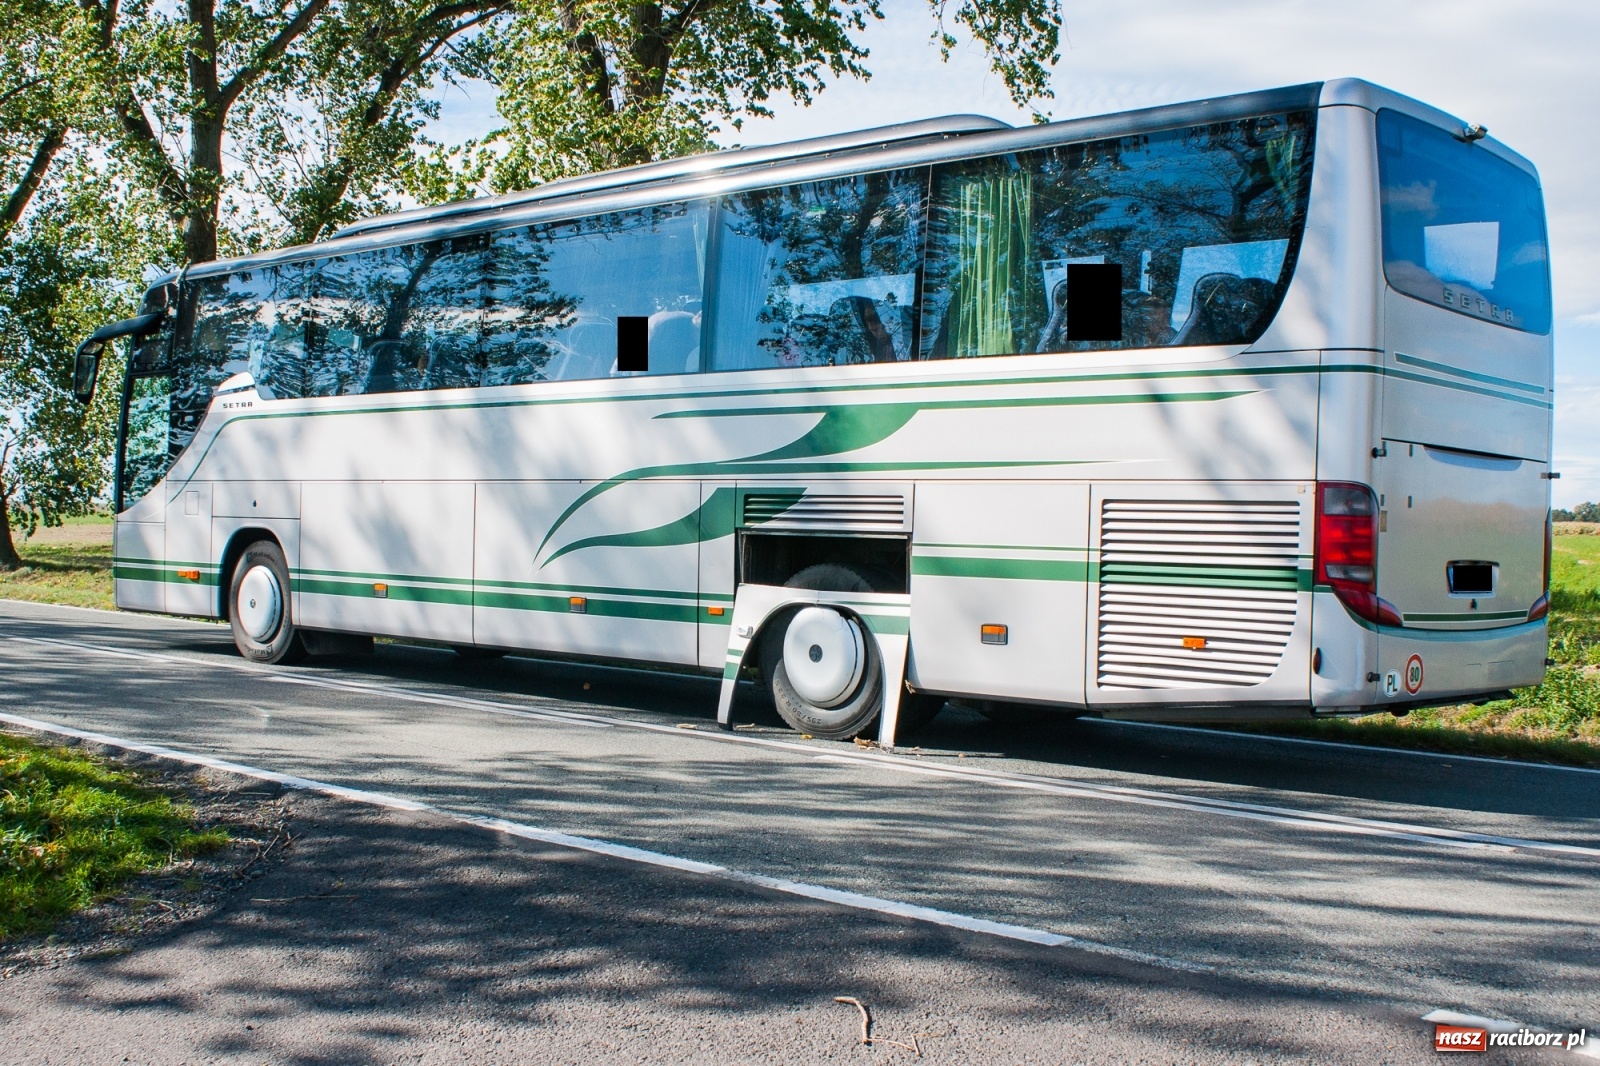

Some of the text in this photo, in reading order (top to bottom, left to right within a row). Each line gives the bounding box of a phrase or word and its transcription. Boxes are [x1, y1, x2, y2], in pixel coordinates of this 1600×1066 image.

[1443, 287, 1514, 322] SETRA
[223, 401, 253, 409] SETRA
[1410, 666, 1420, 682] 80
[1386, 674, 1398, 693] PL
